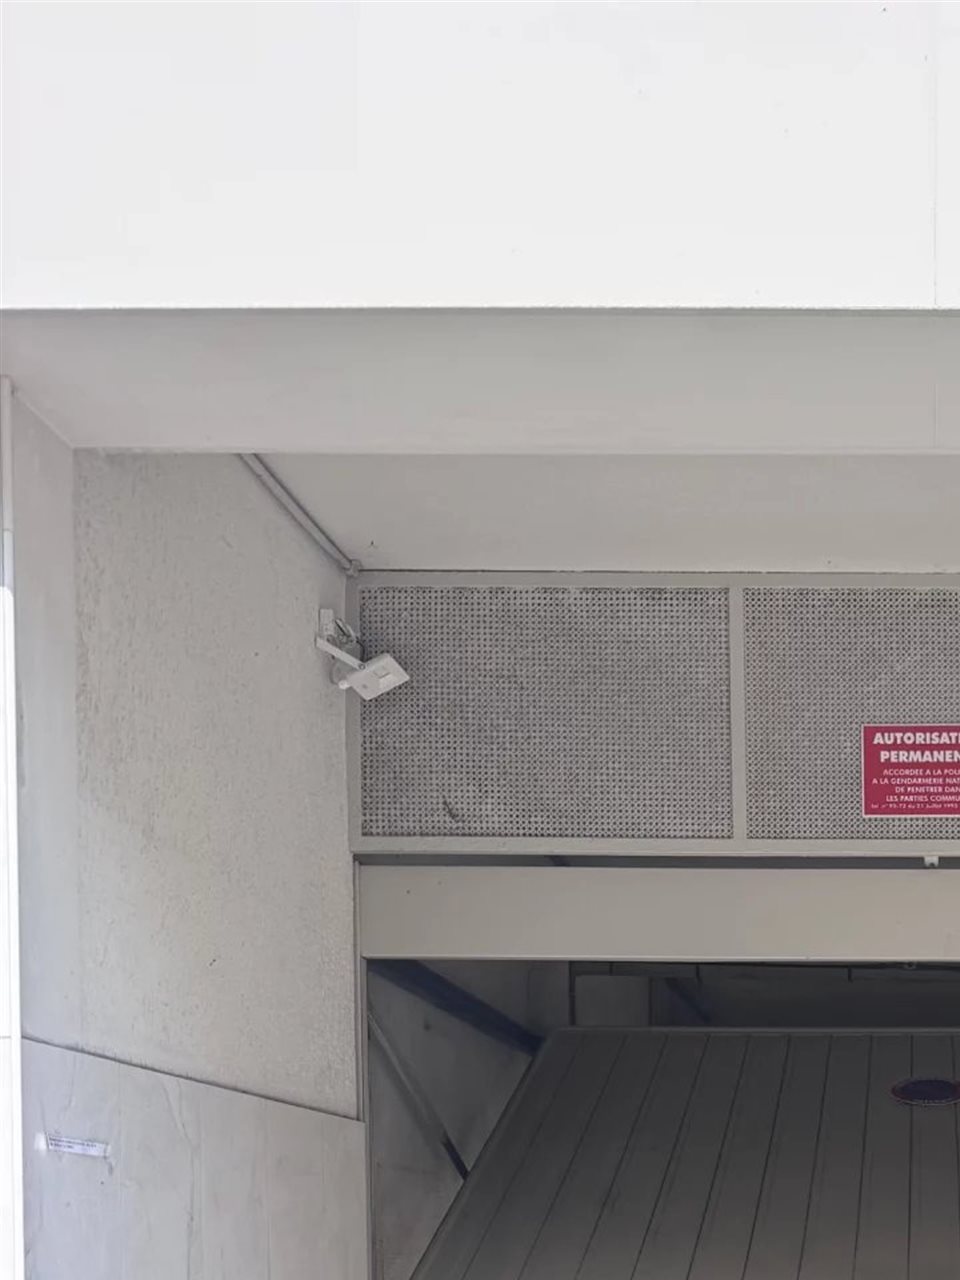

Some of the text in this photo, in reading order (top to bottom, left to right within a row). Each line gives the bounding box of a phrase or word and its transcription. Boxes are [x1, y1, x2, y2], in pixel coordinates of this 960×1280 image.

[872, 777, 878, 785] A
[880, 777, 889, 785] LA
[891, 777, 943, 785] GENDARMERIE
